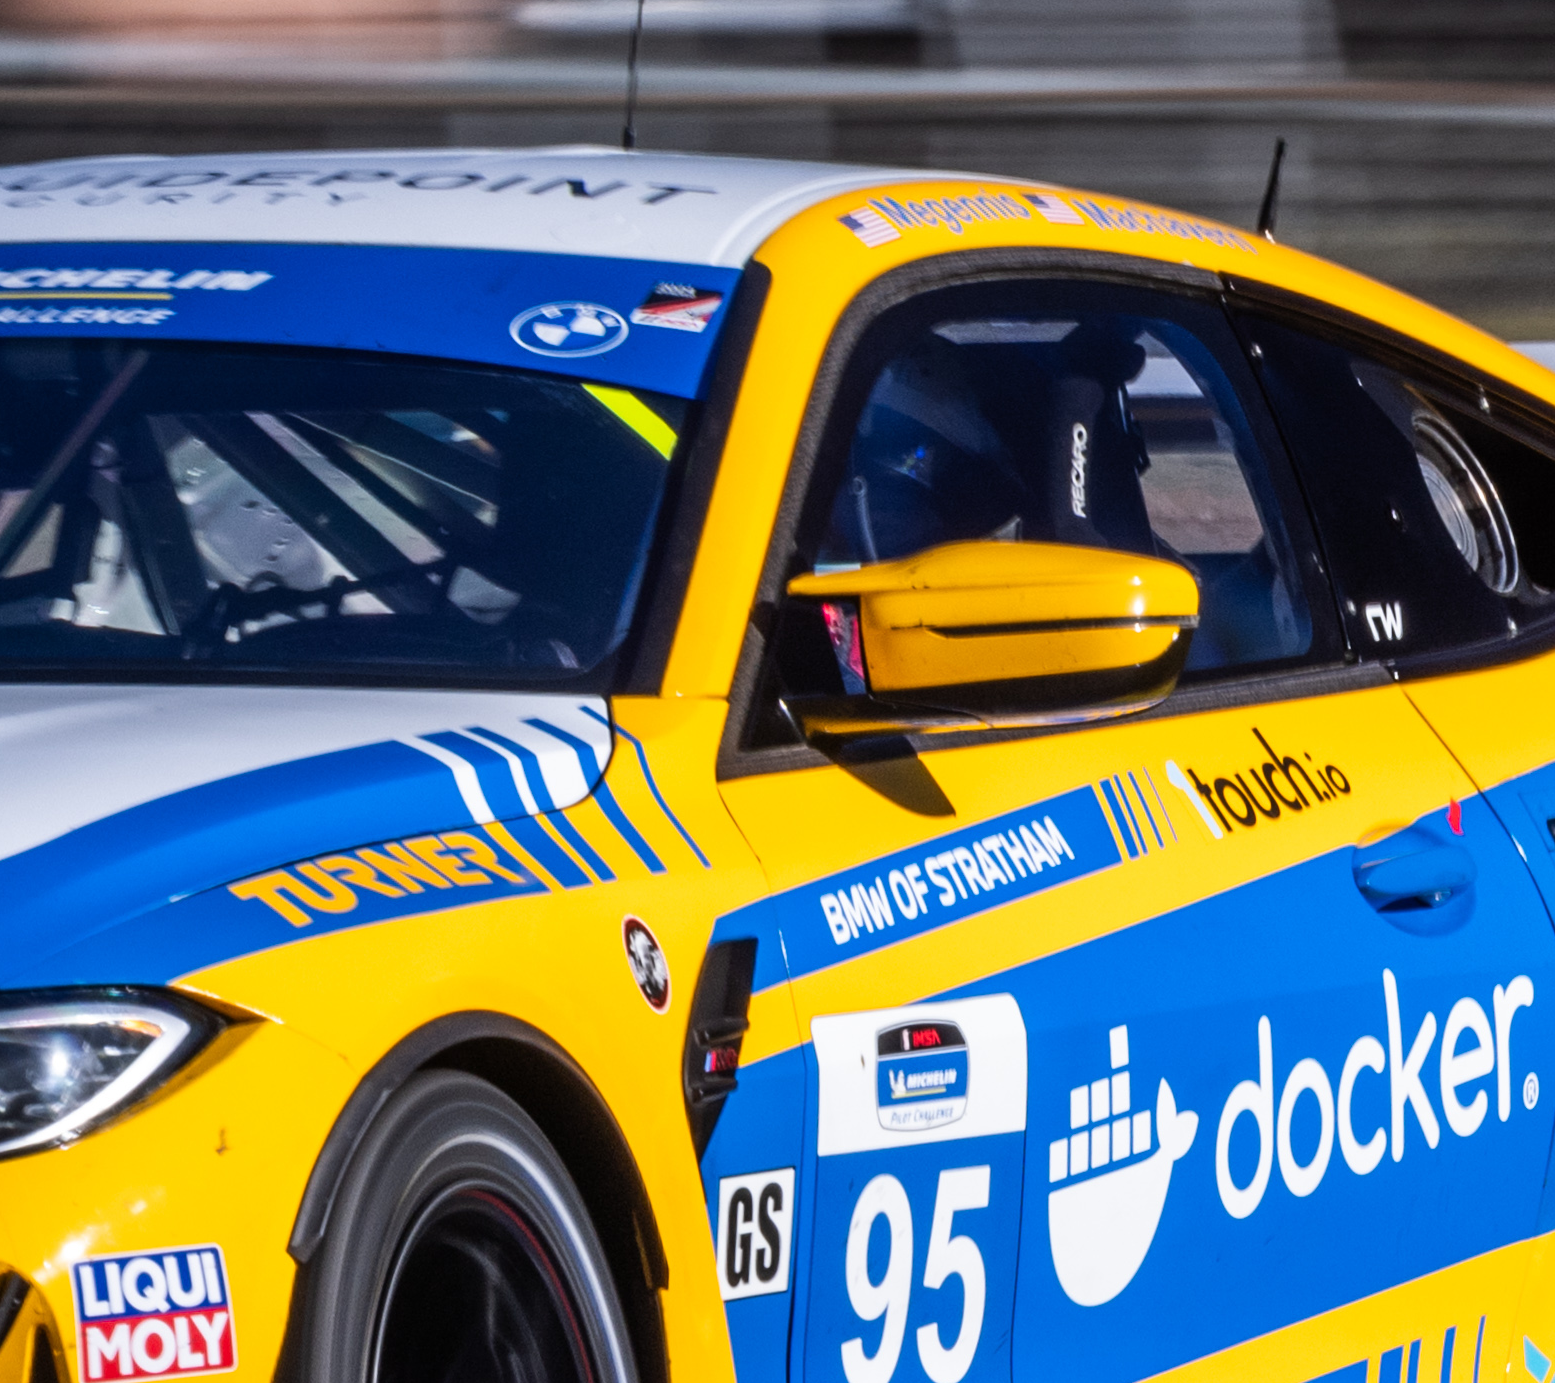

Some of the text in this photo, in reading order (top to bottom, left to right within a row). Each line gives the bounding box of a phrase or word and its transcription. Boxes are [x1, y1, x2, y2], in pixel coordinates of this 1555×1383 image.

[867, 187, 1031, 235] Megennis
[1072, 422, 1088, 519] RECARO
[228, 832, 526, 928] TURNER
[820, 815, 1075, 945] BMW OF STRATHAM
[906, 1068, 958, 1090] MICHELIN
[726, 1182, 783, 1288] GS
[78, 1251, 223, 1318] LIQUI
[85, 1312, 229, 1380] MOLY
